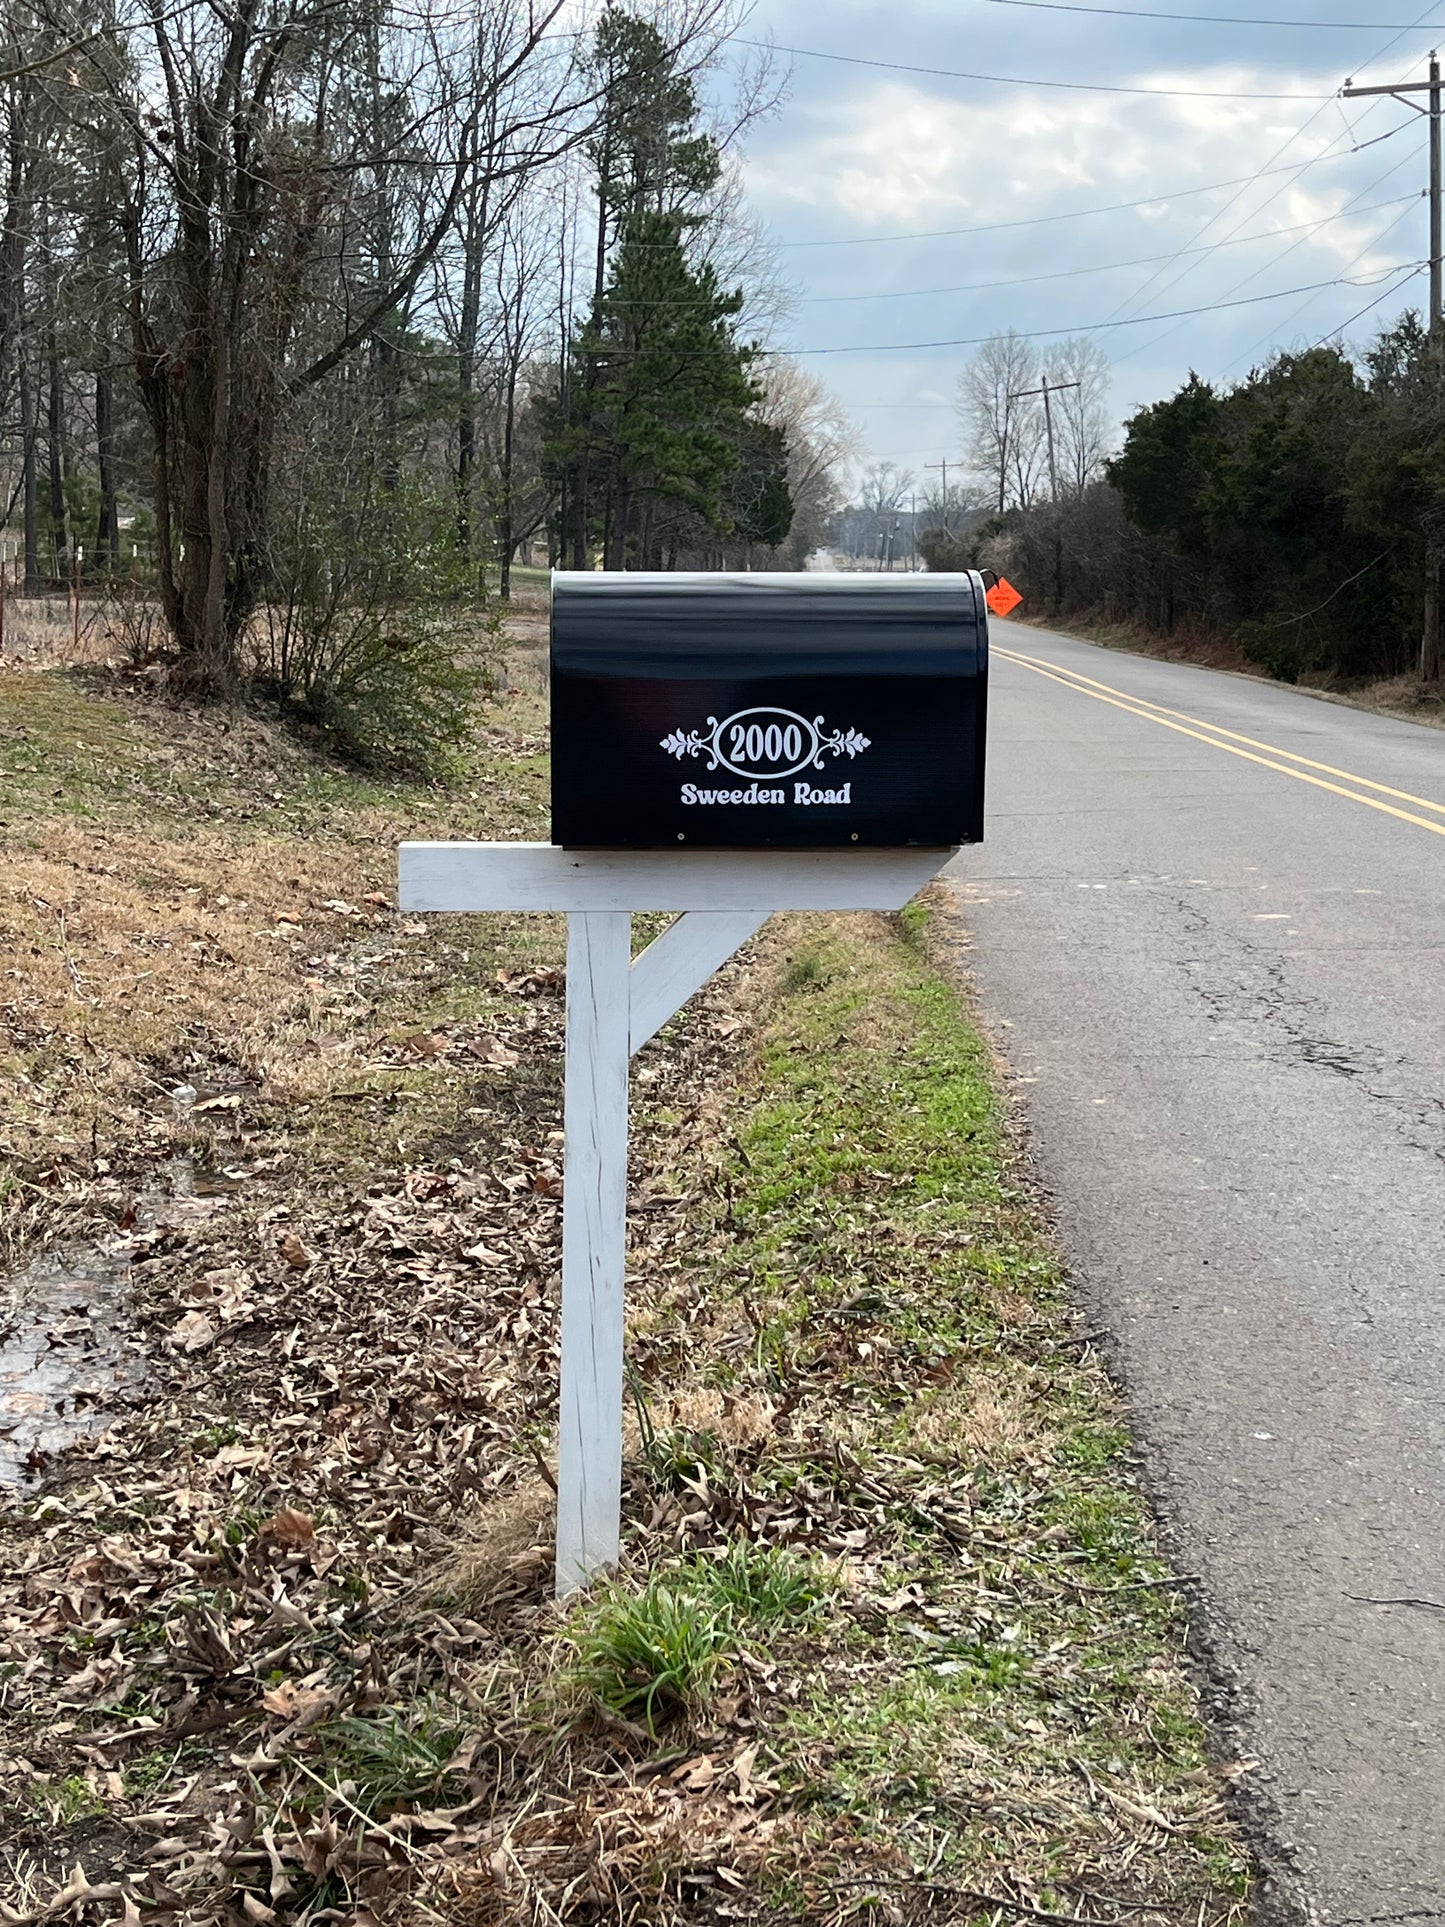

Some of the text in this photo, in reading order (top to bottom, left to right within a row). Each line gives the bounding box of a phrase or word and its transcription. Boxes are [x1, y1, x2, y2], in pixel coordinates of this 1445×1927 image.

[730, 724, 802, 762] 2000
[680, 782, 851, 805] Sweeden Road
